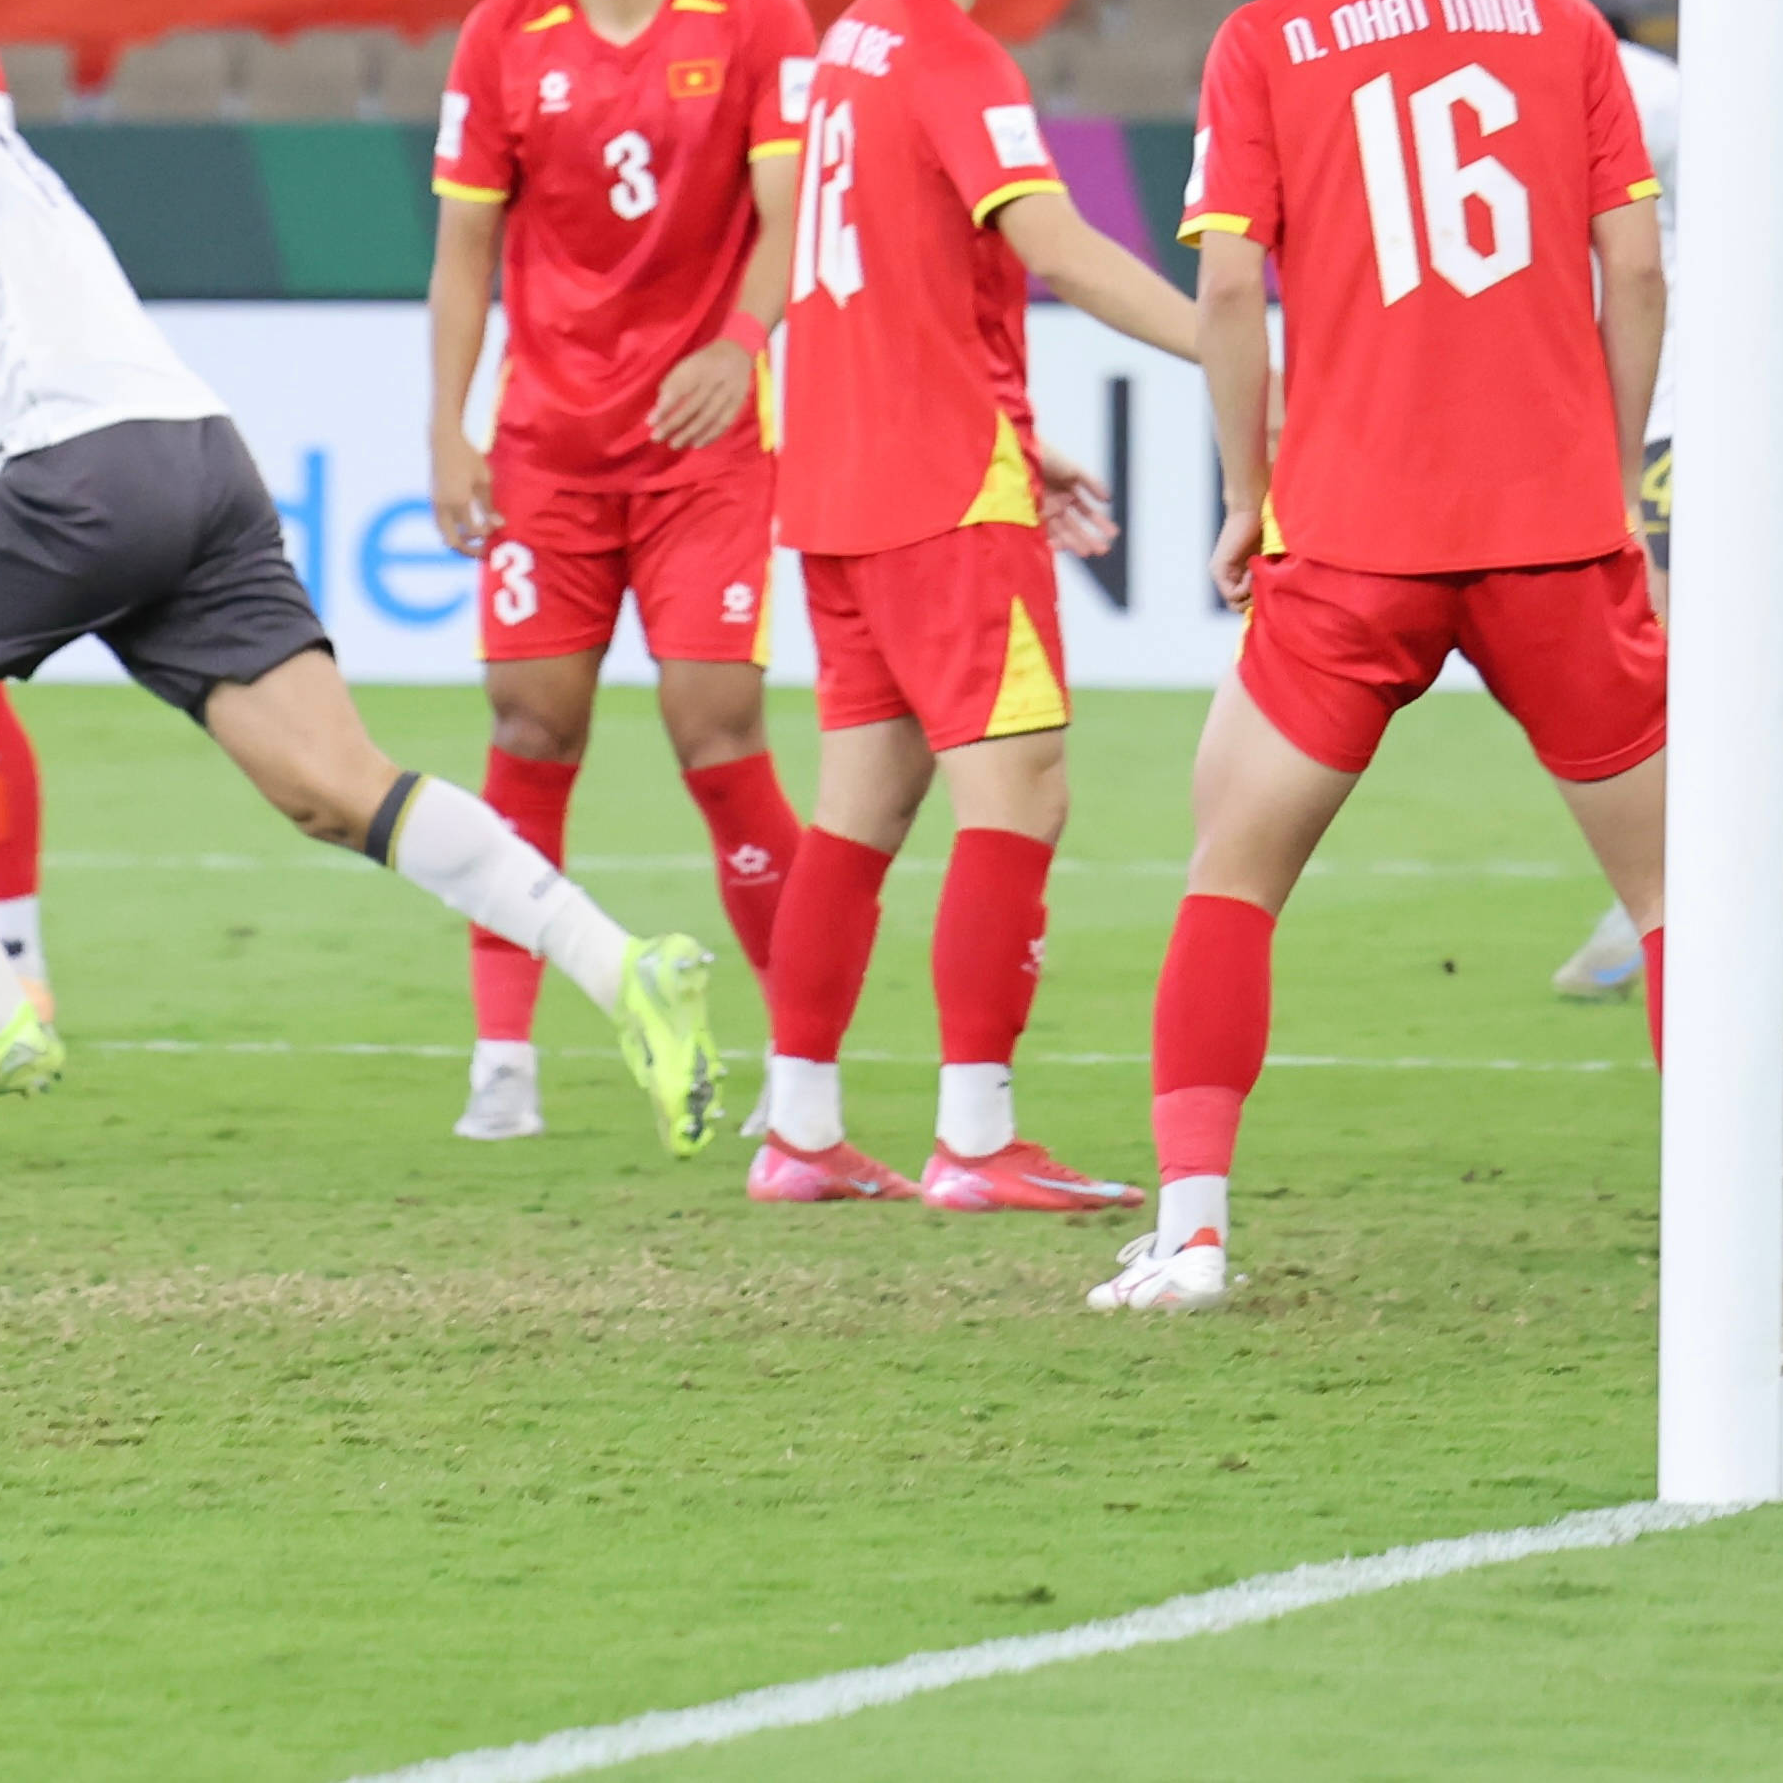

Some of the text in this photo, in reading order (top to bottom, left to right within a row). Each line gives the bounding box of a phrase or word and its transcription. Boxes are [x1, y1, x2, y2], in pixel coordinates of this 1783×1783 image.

[603, 131, 658, 222] 3
[791, 98, 865, 309] 12
[1351, 62, 1533, 308] 16
[490, 541, 539, 627] 3
